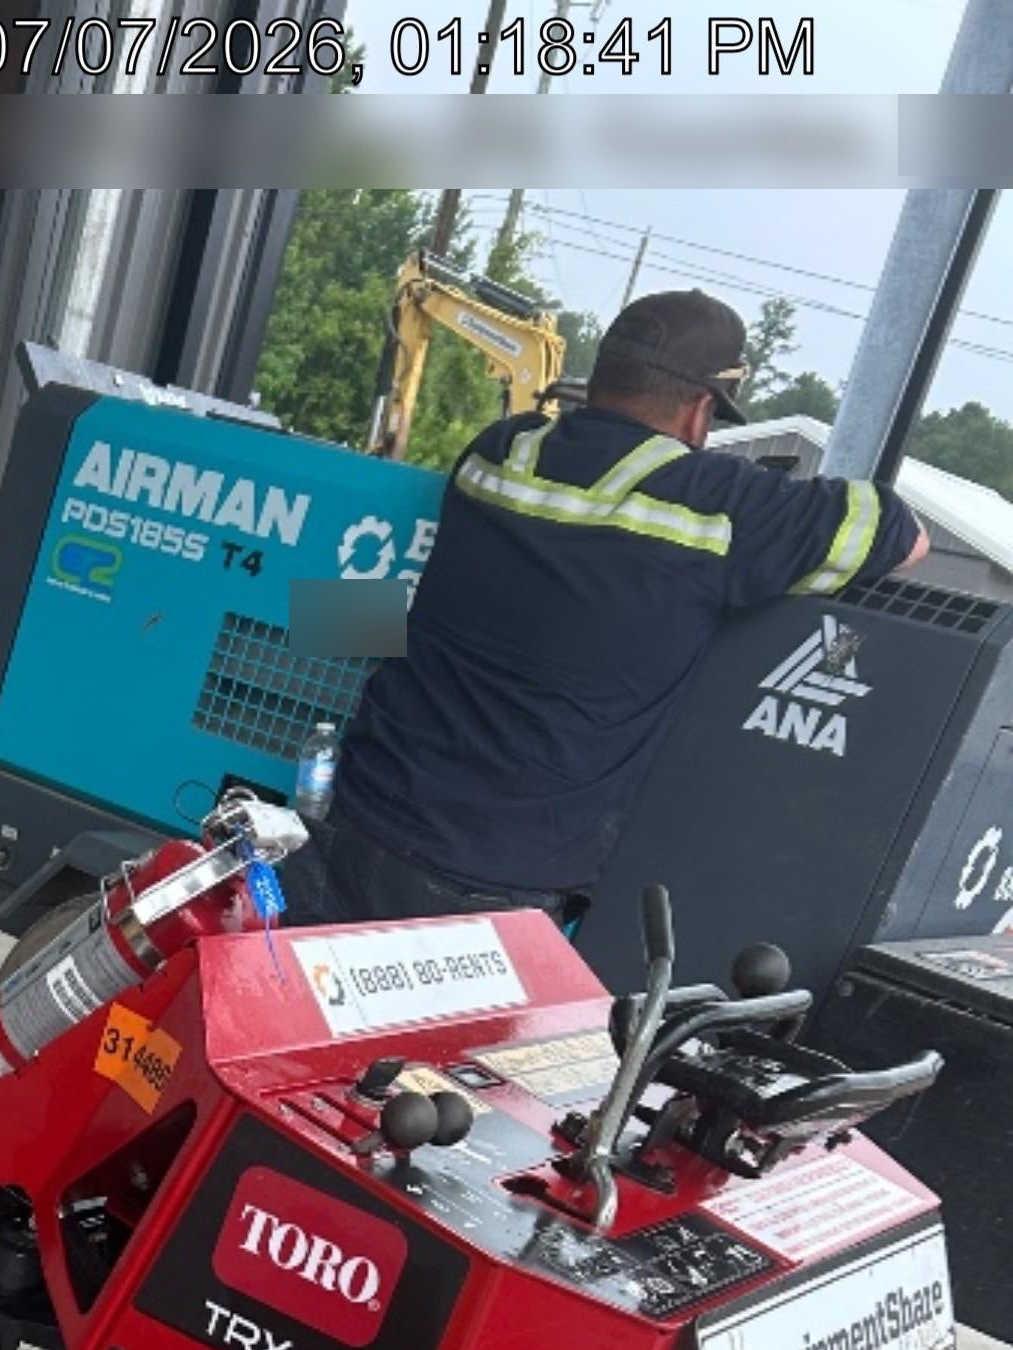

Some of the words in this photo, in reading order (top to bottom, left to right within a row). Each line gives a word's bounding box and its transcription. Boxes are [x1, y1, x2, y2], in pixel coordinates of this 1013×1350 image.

[73, 441, 310, 546] AIRMAN
[220, 541, 264, 577] T4
[742, 696, 848, 757] ANA
[239, 1204, 381, 1303] TORO
